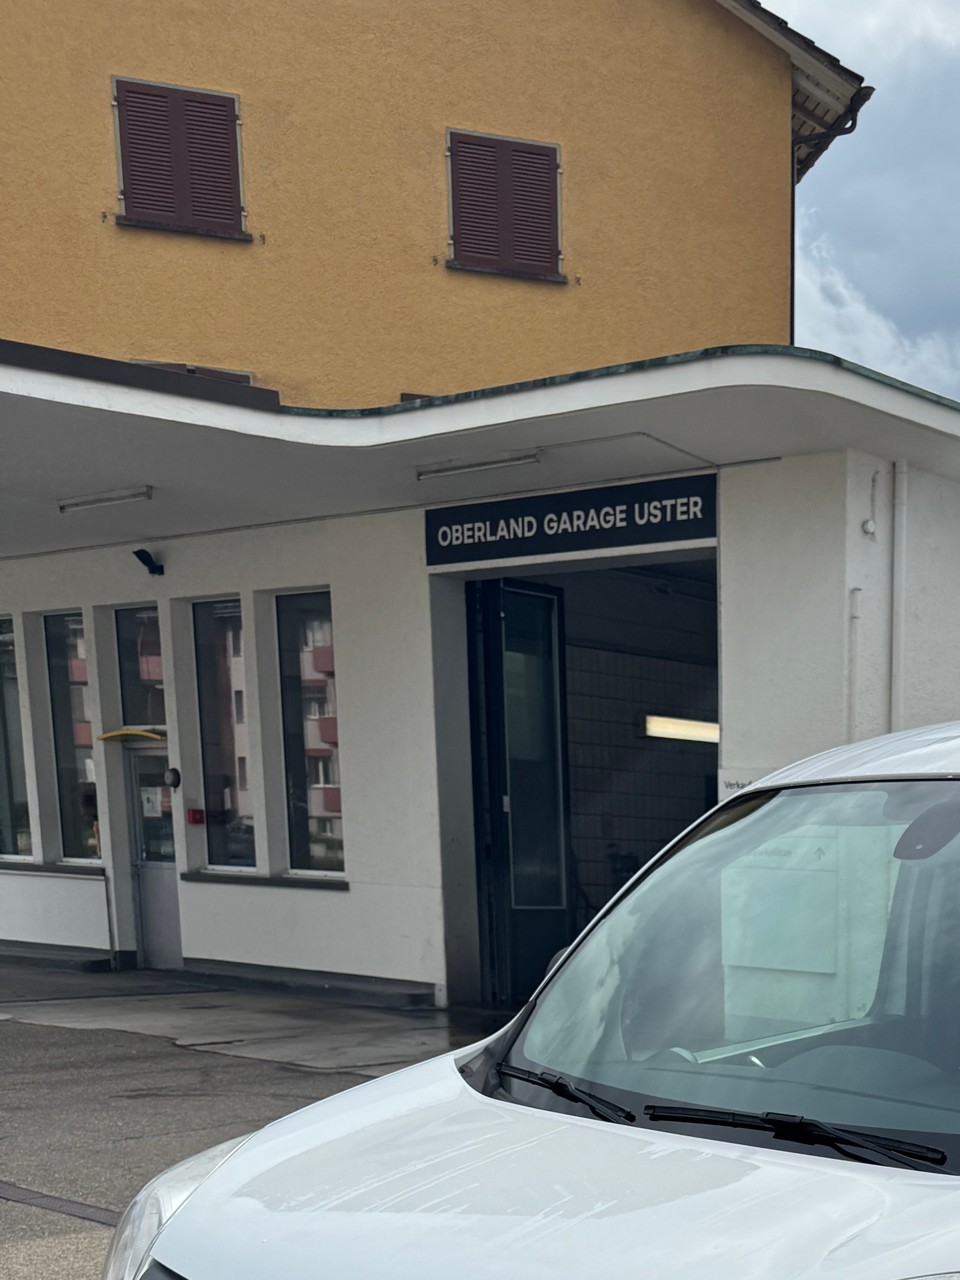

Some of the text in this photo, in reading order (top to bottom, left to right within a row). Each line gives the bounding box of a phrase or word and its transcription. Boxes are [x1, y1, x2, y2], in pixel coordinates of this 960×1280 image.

[437, 496, 703, 547] OBERLAND GARAGE USTER
